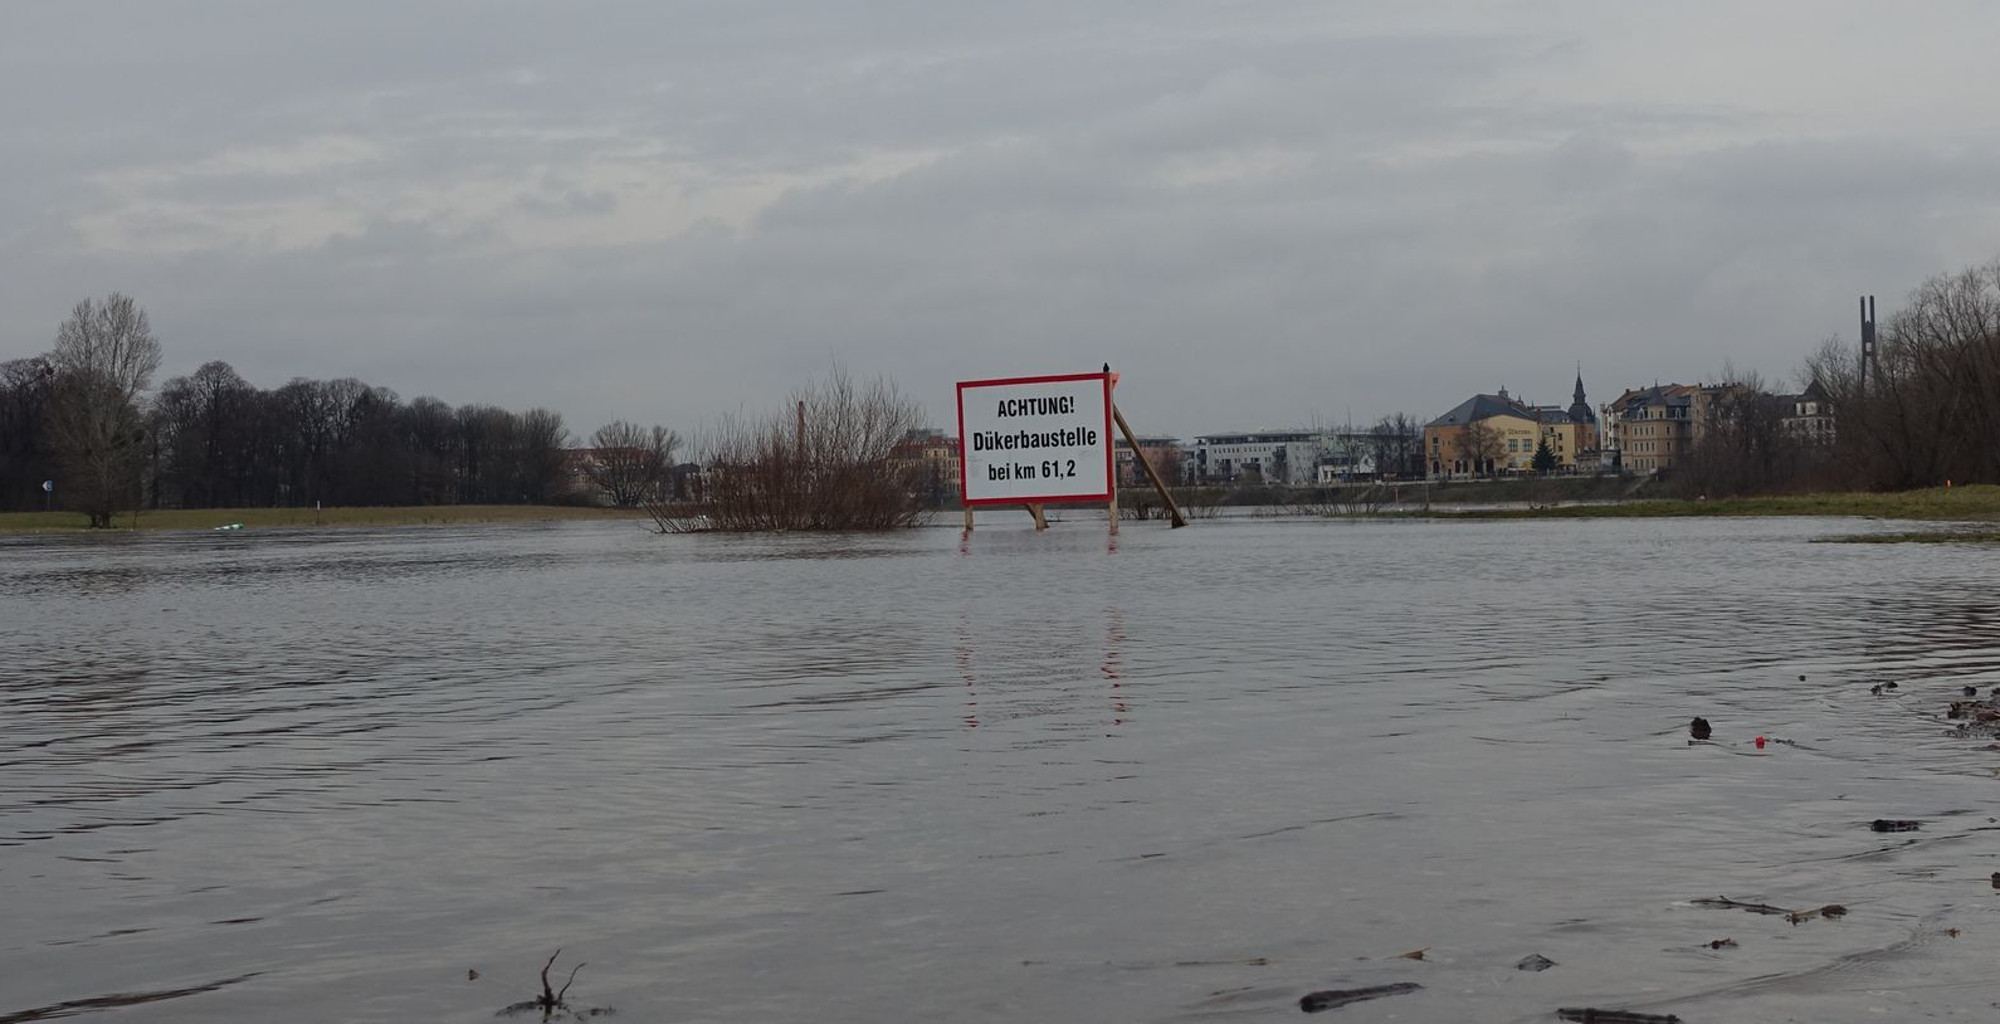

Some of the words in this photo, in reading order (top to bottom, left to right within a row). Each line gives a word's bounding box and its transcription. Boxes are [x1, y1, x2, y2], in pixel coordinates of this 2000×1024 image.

[998, 396, 1075, 418] ACHTUNG!
[973, 427, 1097, 451] Dükerbaustelle
[988, 463, 1010, 481] bei
[1015, 462, 1036, 480] km
[1042, 460, 1076, 481] 61,2
